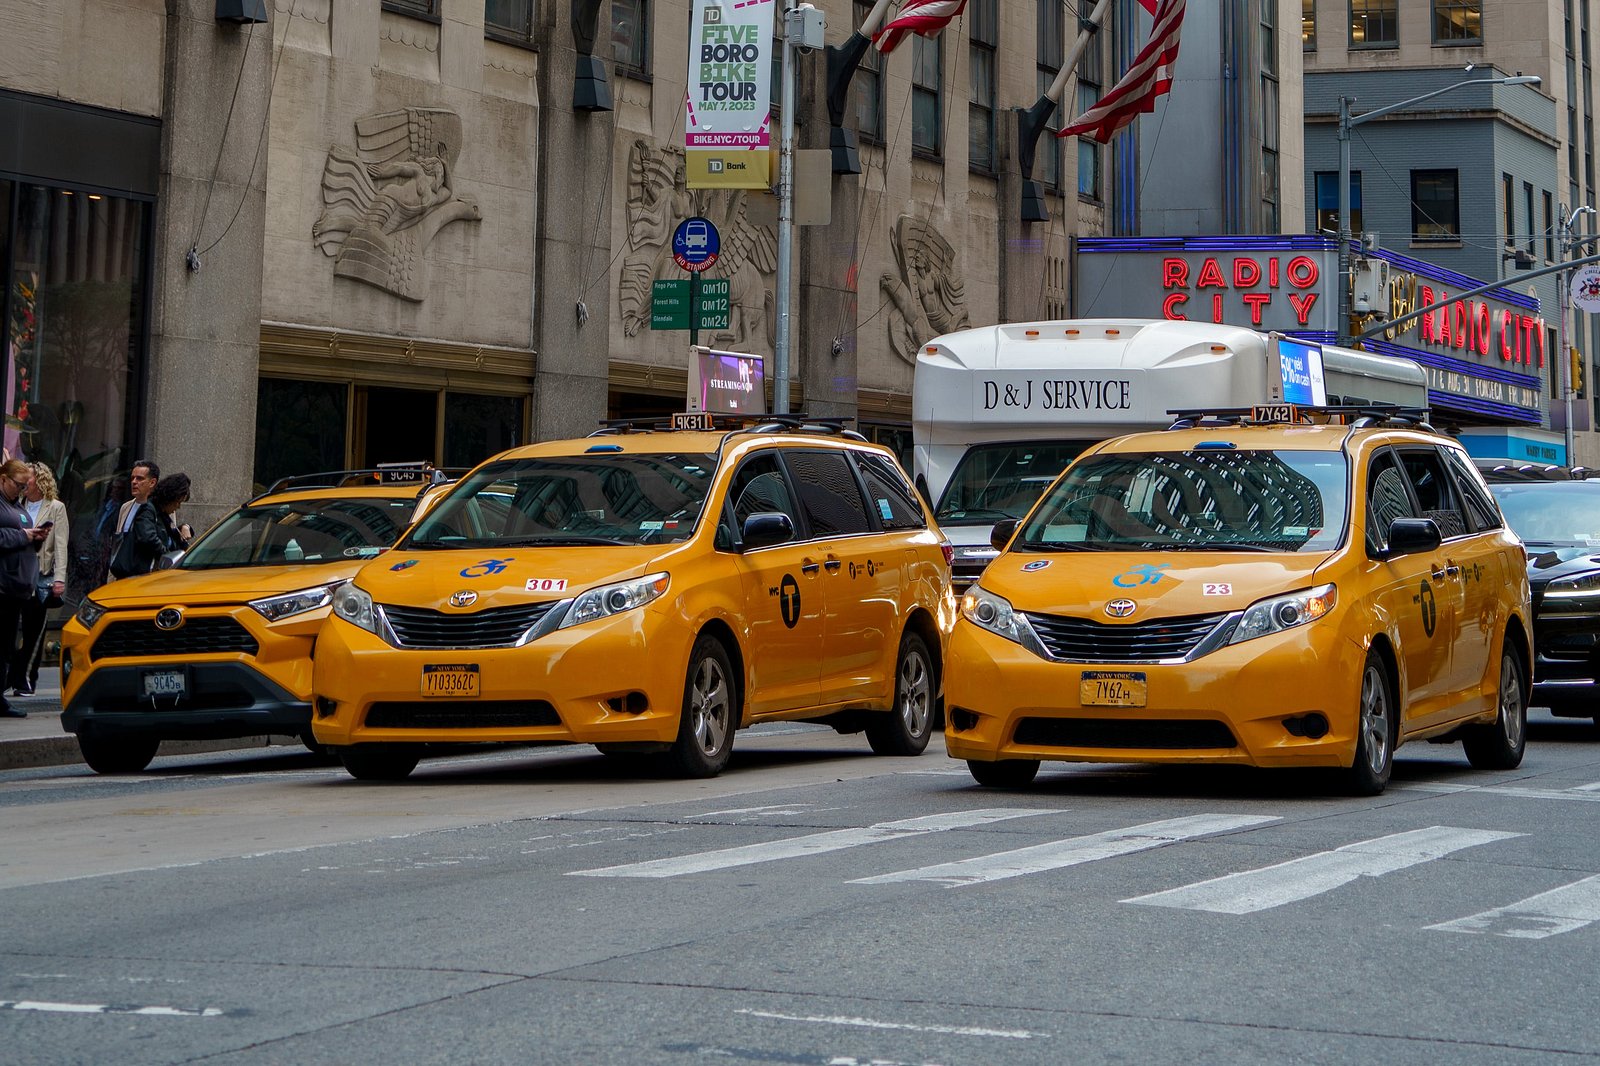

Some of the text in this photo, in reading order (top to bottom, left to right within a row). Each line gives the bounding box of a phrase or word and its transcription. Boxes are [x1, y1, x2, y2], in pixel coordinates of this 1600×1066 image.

[706, 8, 720, 21] TD
[701, 25, 759, 44] FIVE
[701, 44, 759, 63] BORO
[700, 63, 757, 82] BIKE
[700, 82, 757, 101] TOUR
[698, 102, 755, 112] MAY 7, 2023
[693, 135, 760, 144] BIKE.NYC/TOUR
[709, 161, 746, 171] TD Bank
[676, 255, 715, 271] NO STANDING
[1163, 255, 1319, 289] RADIO
[702, 282, 728, 295] QM10
[702, 298, 727, 311] QM12
[1163, 292, 1319, 325] CITY
[701, 315, 728, 328] QM24
[1420, 285, 1491, 355] RADIO
[1501, 309, 1545, 368] CITY
[710, 379, 741, 390] STREAMING
[1475, 378, 1504, 401] FONSECA
[984, 380, 1131, 410] D & J SERVICE
[1258, 407, 1289, 422] 7Y62
[677, 416, 702, 429] 9K31
[527, 579, 566, 591] 301
[1205, 584, 1230, 595] 23
[769, 585, 796, 622] NYC T
[427, 673, 474, 690] Y103362C
